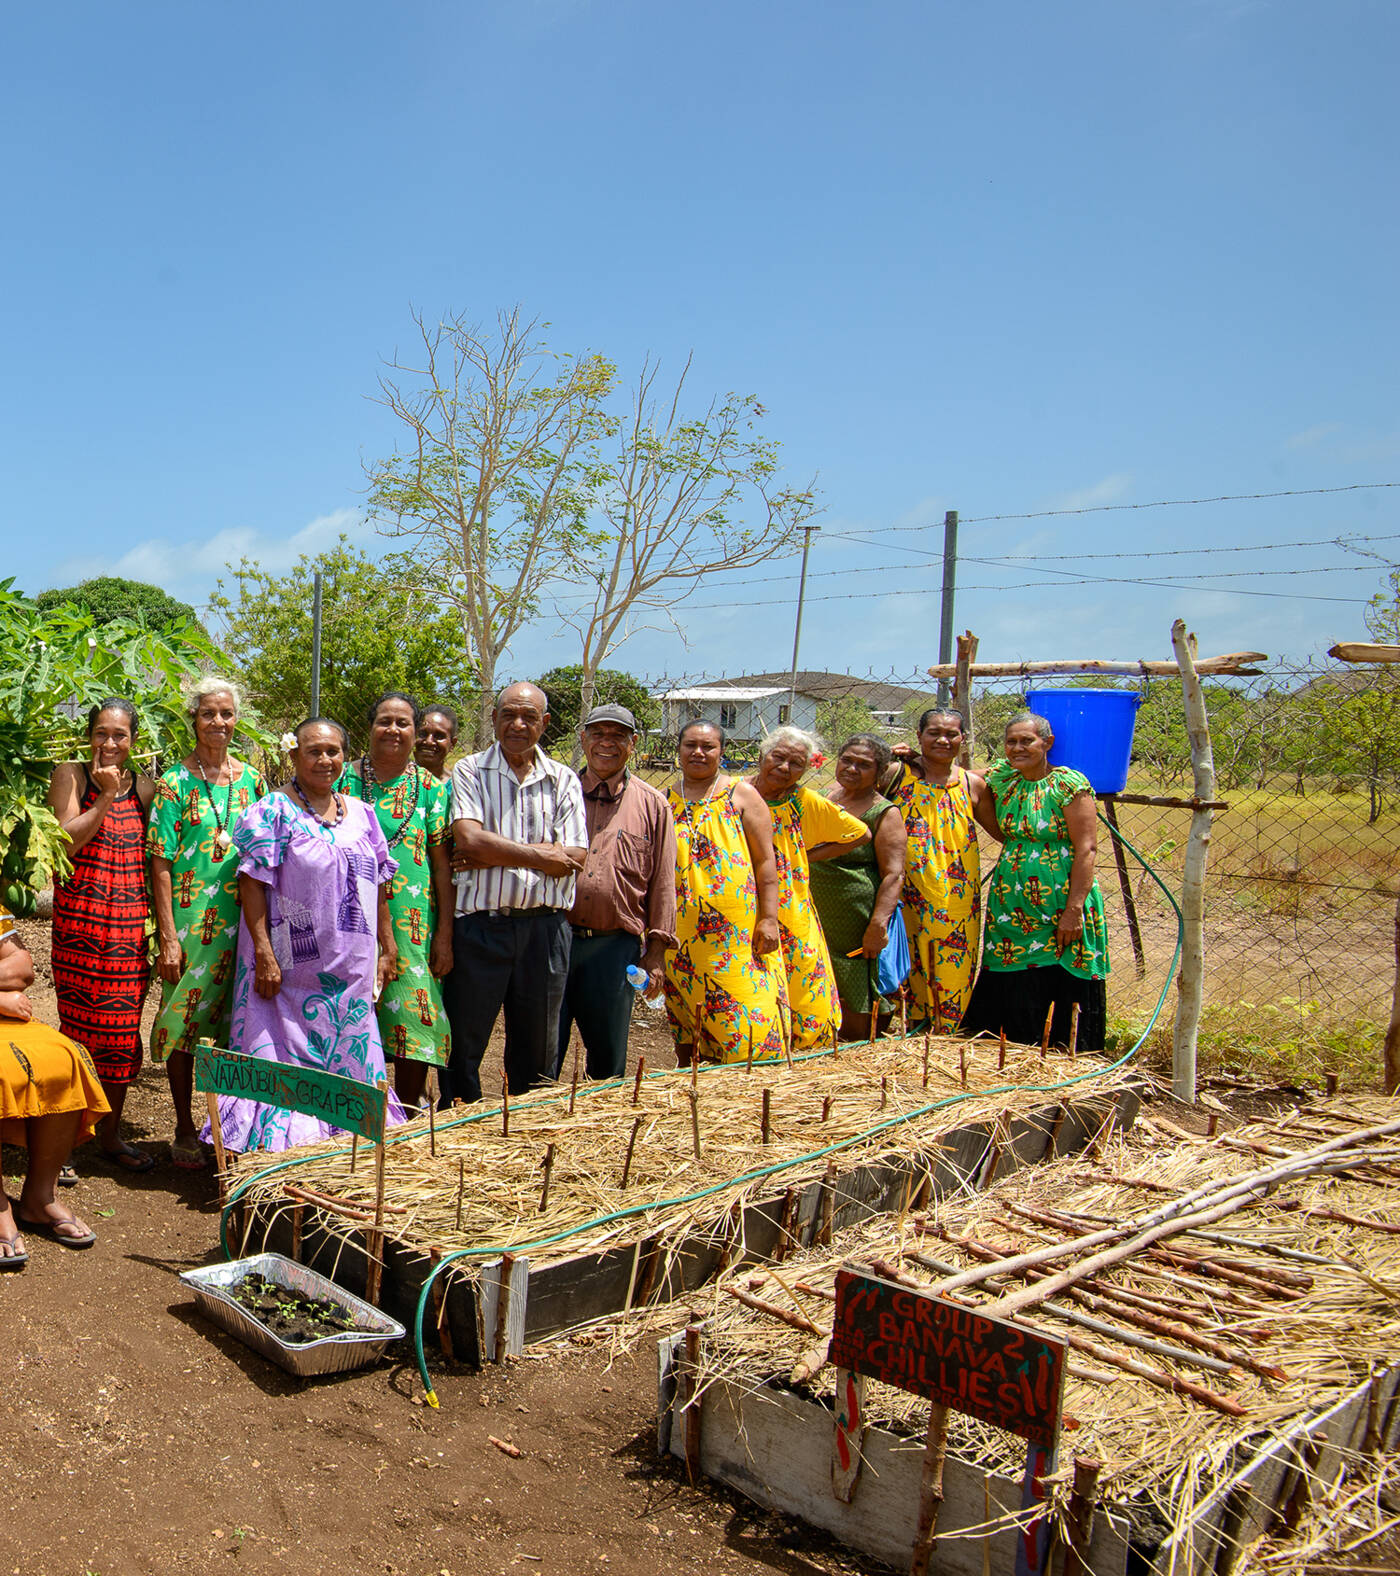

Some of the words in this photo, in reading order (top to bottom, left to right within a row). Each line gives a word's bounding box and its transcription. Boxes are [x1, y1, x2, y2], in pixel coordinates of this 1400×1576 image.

[295, 1080, 365, 1122] GRAPES
[879, 1312, 1007, 1378] BANAVA
[892, 1292, 993, 1344] GROUP
[1003, 1328, 1025, 1360] 2
[867, 1340, 1021, 1416] CHILLIES
